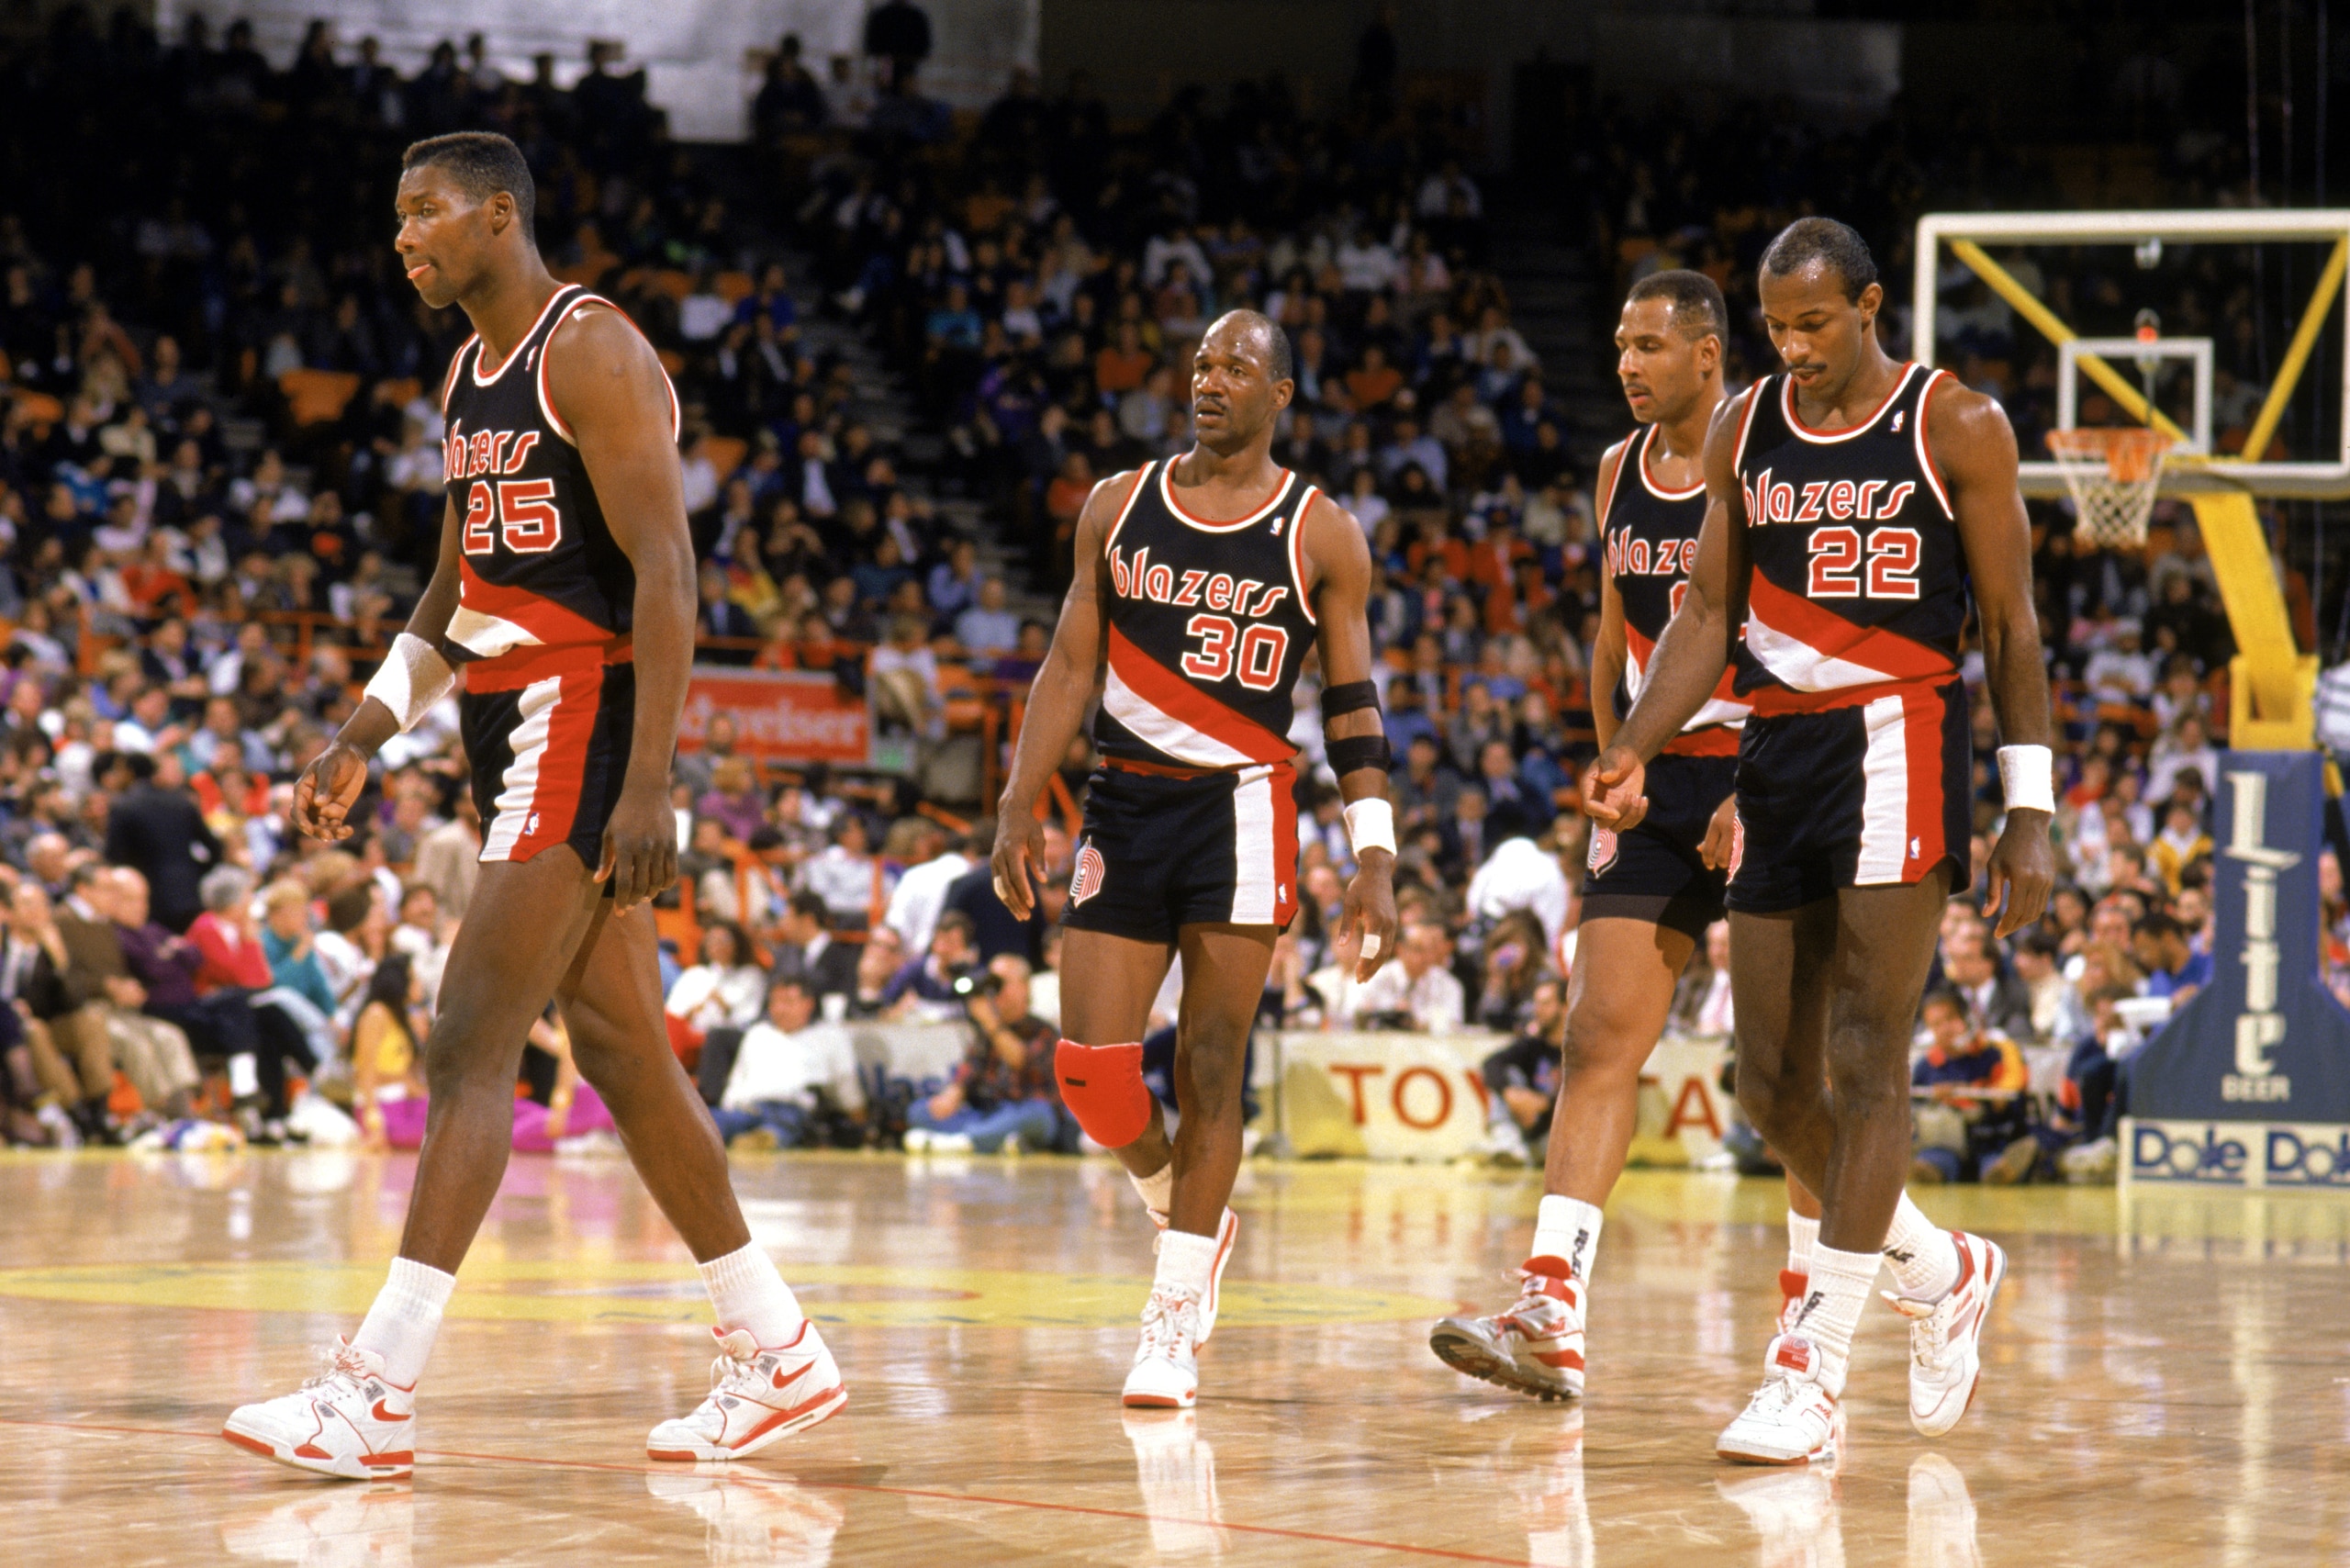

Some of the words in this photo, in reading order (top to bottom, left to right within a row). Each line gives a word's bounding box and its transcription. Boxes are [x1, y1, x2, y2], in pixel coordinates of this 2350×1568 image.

[463, 477, 562, 555] 25
[1742, 466, 1917, 528] blazers
[1110, 544, 1289, 618] blazers
[1608, 524, 1698, 578] blaze
[1807, 526, 1921, 599] 22
[1181, 613, 1289, 691] 30
[2221, 1074, 2290, 1101] BEER
[2133, 1126, 2249, 1177] Dole
